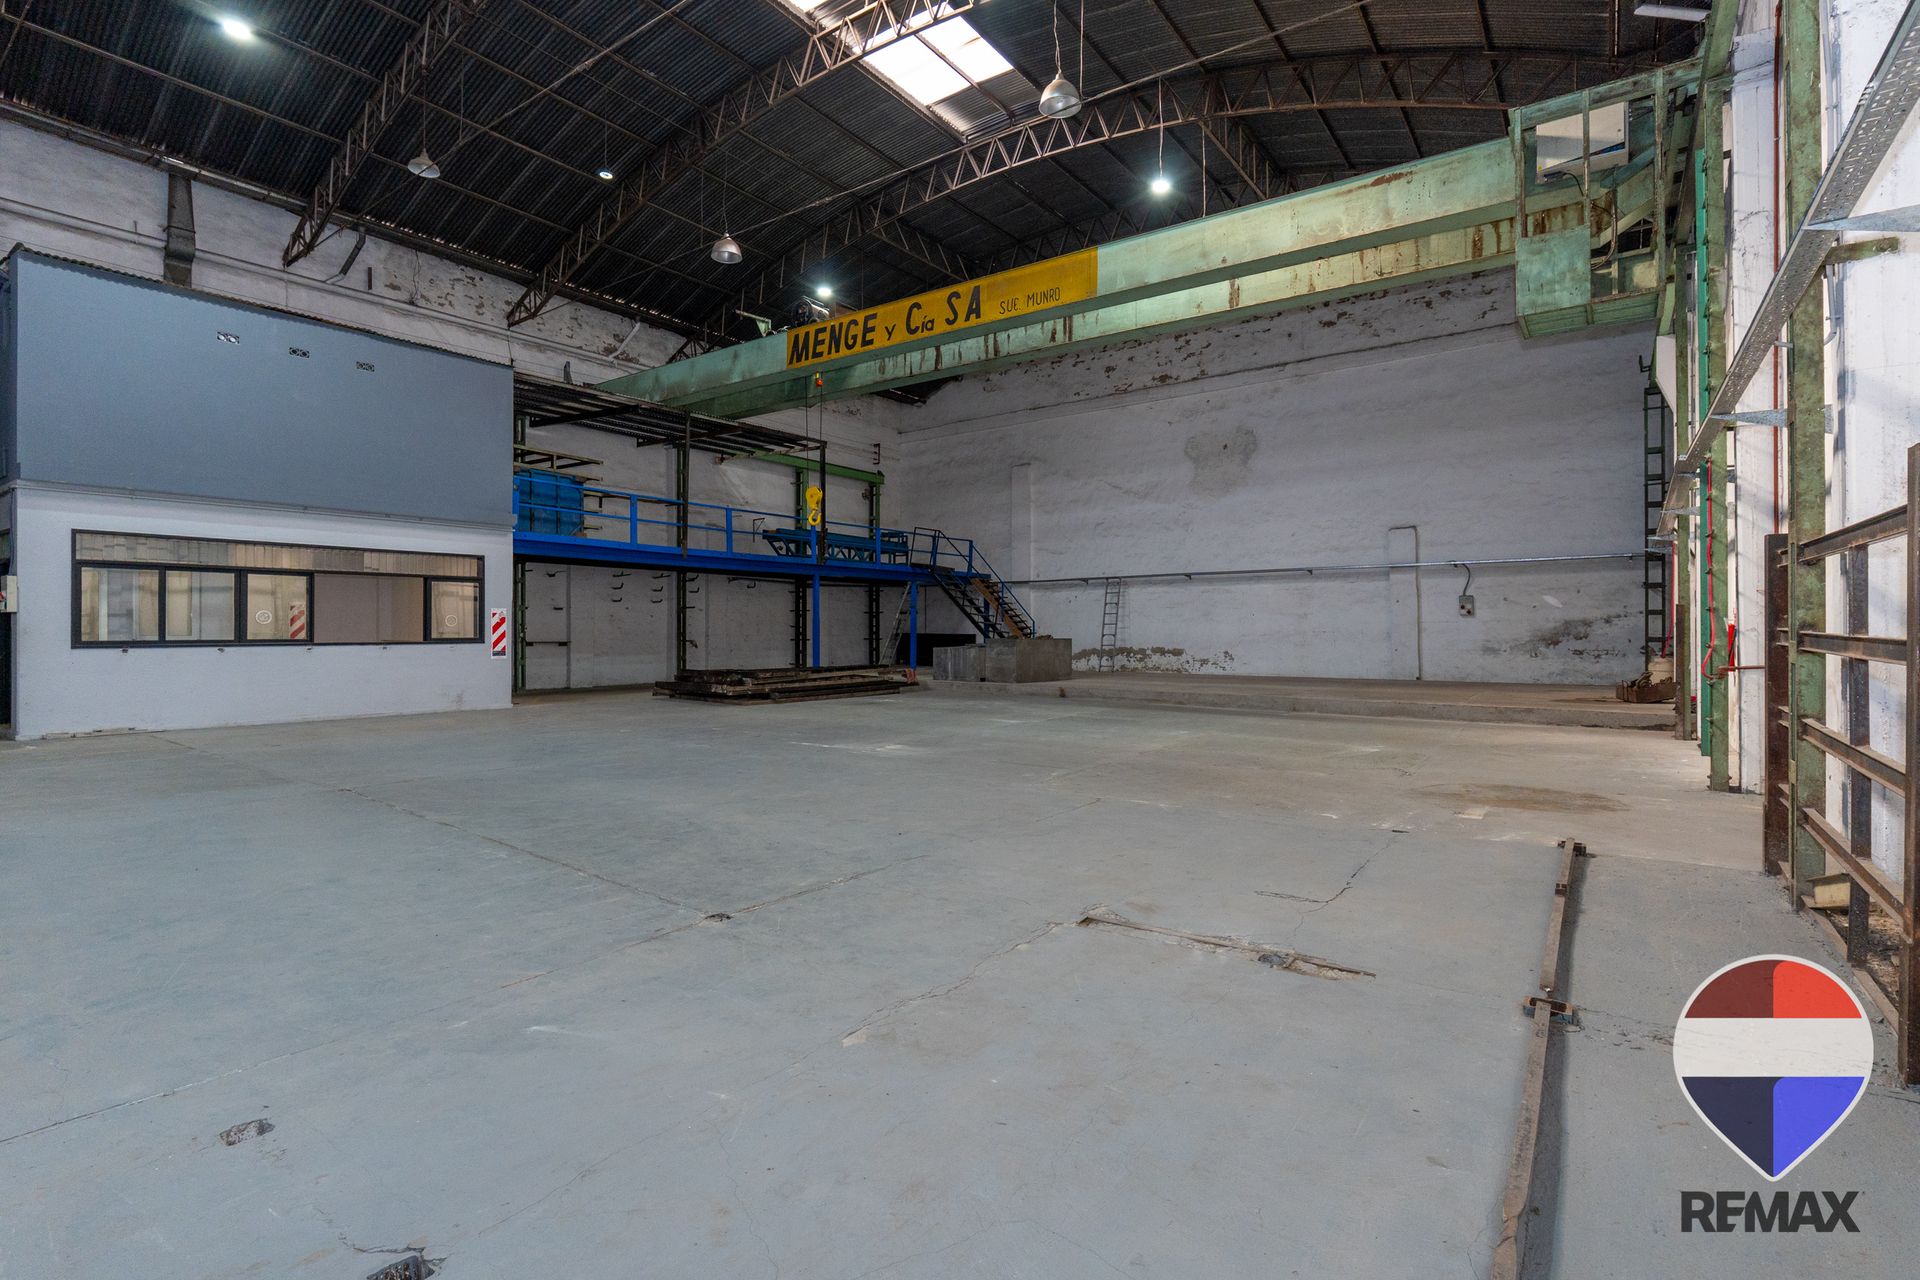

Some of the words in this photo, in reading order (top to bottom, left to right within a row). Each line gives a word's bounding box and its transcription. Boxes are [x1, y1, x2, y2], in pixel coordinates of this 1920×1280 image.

[1027, 287, 1061, 308] MUNRO
[788, 313, 877, 365] MENGE
[944, 285, 981, 325] SA
